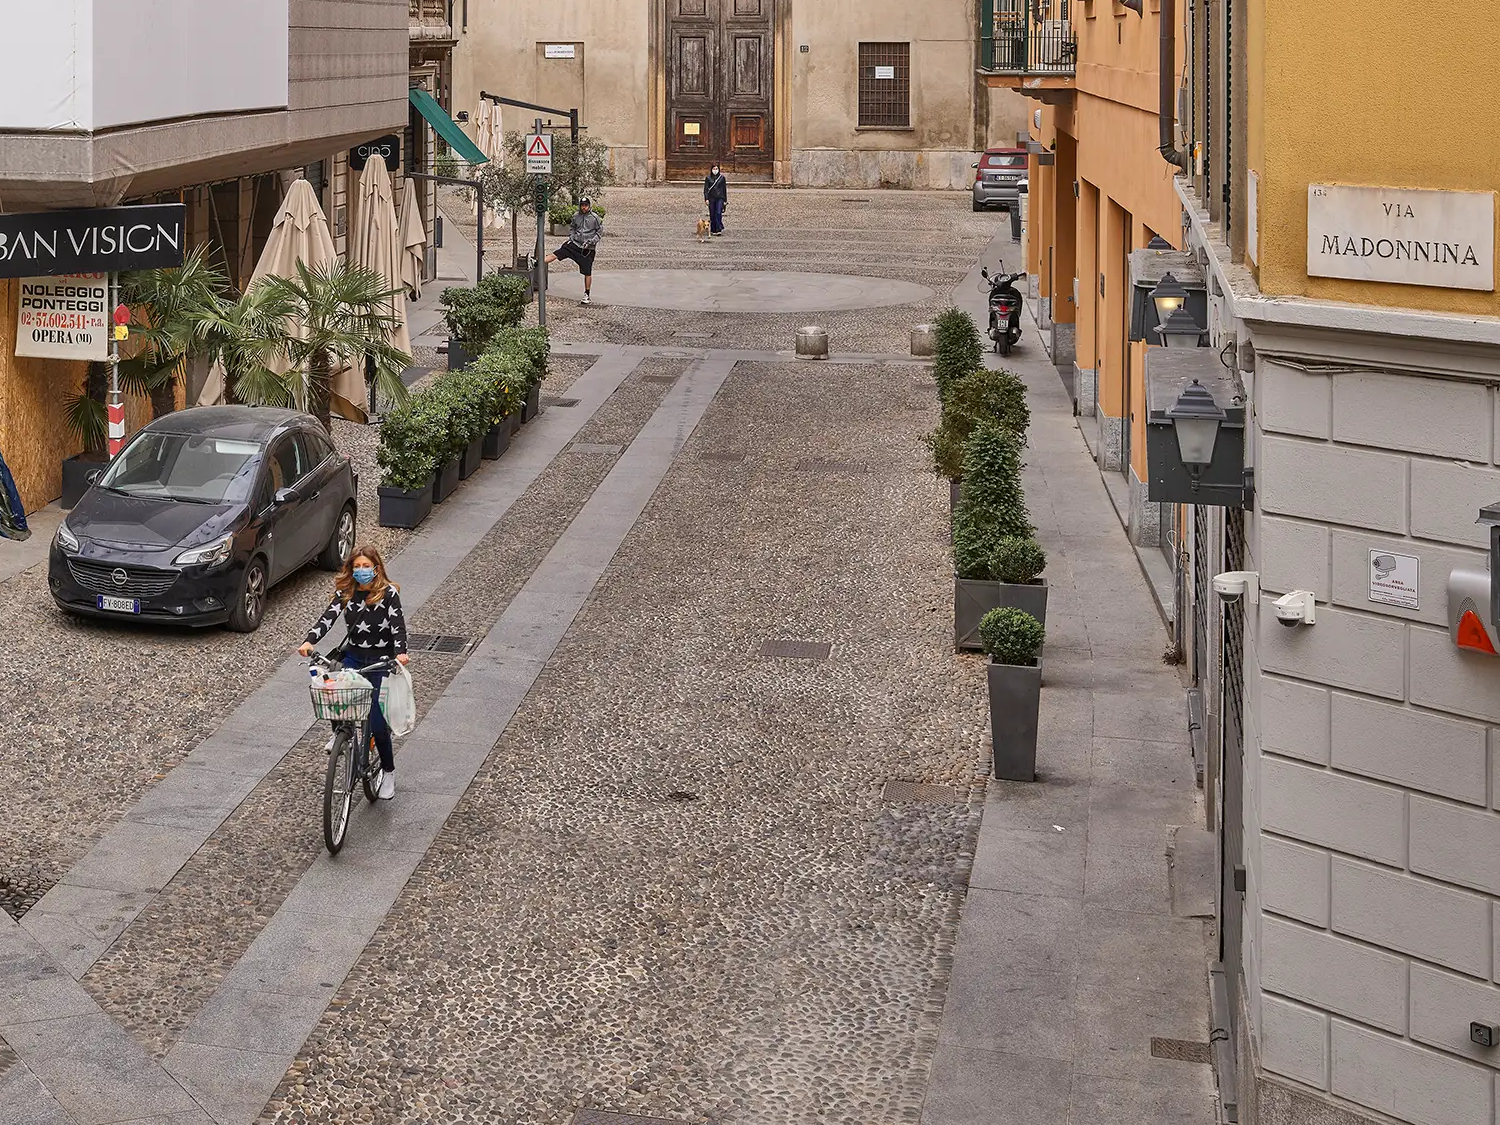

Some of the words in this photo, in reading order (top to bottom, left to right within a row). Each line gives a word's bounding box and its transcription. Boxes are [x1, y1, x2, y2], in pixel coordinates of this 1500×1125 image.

[1382, 202, 1415, 218] VIA
[66, 222, 180, 257] VISION
[1320, 234, 1480, 266] MADONNINA
[22, 284, 105, 299] NOLEGGIO
[21, 297, 104, 312] PONTEGGI
[32, 329, 73, 344] OPERA
[75, 333, 92, 345] (MI)
